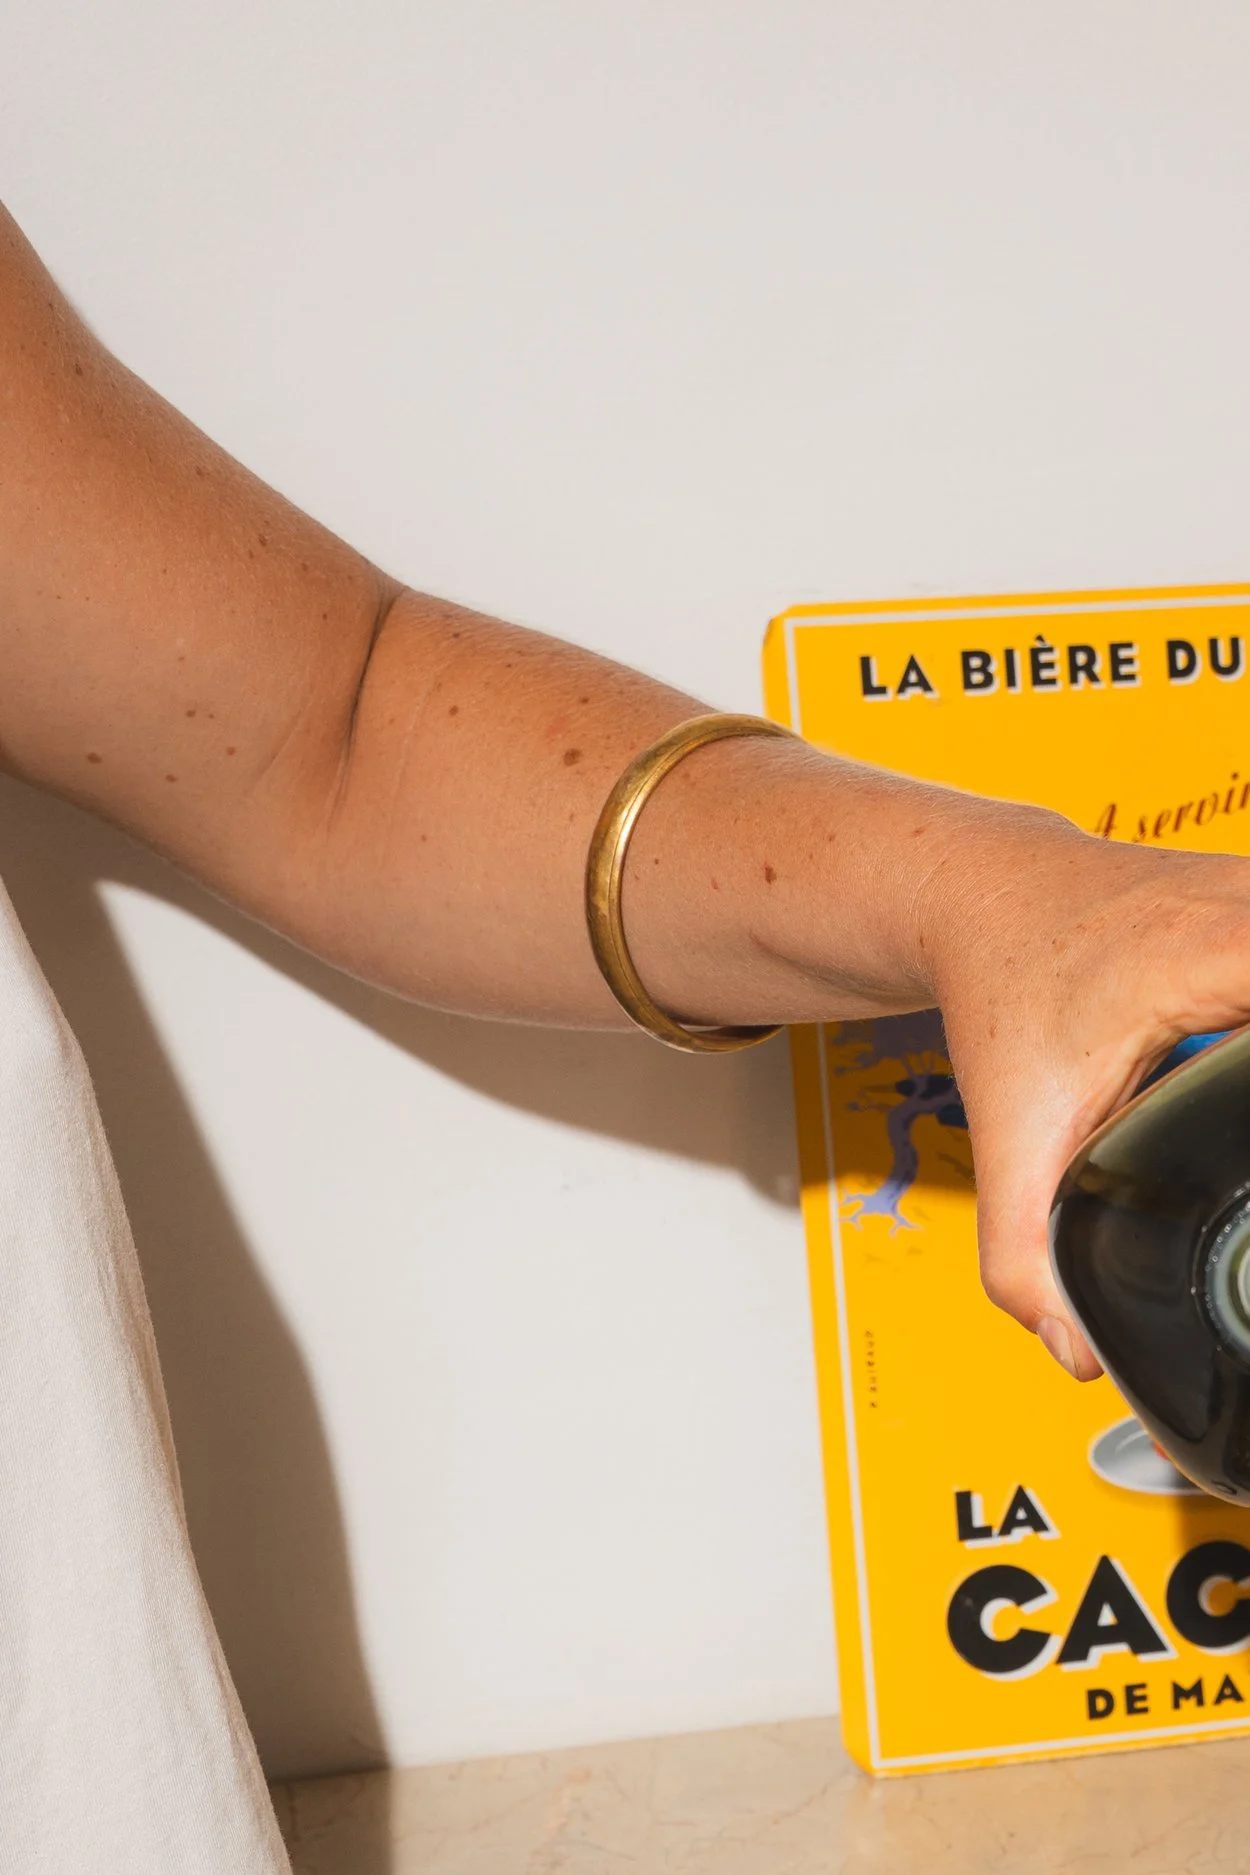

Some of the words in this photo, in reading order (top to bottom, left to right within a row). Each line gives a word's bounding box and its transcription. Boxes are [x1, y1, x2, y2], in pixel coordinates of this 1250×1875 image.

[859, 655, 934, 697] LA
[960, 634, 1140, 692] BIÈRE
[1166, 636, 1245, 681] DU
[955, 1484, 1058, 1548] LA
[1085, 1682, 1150, 1721] DE
